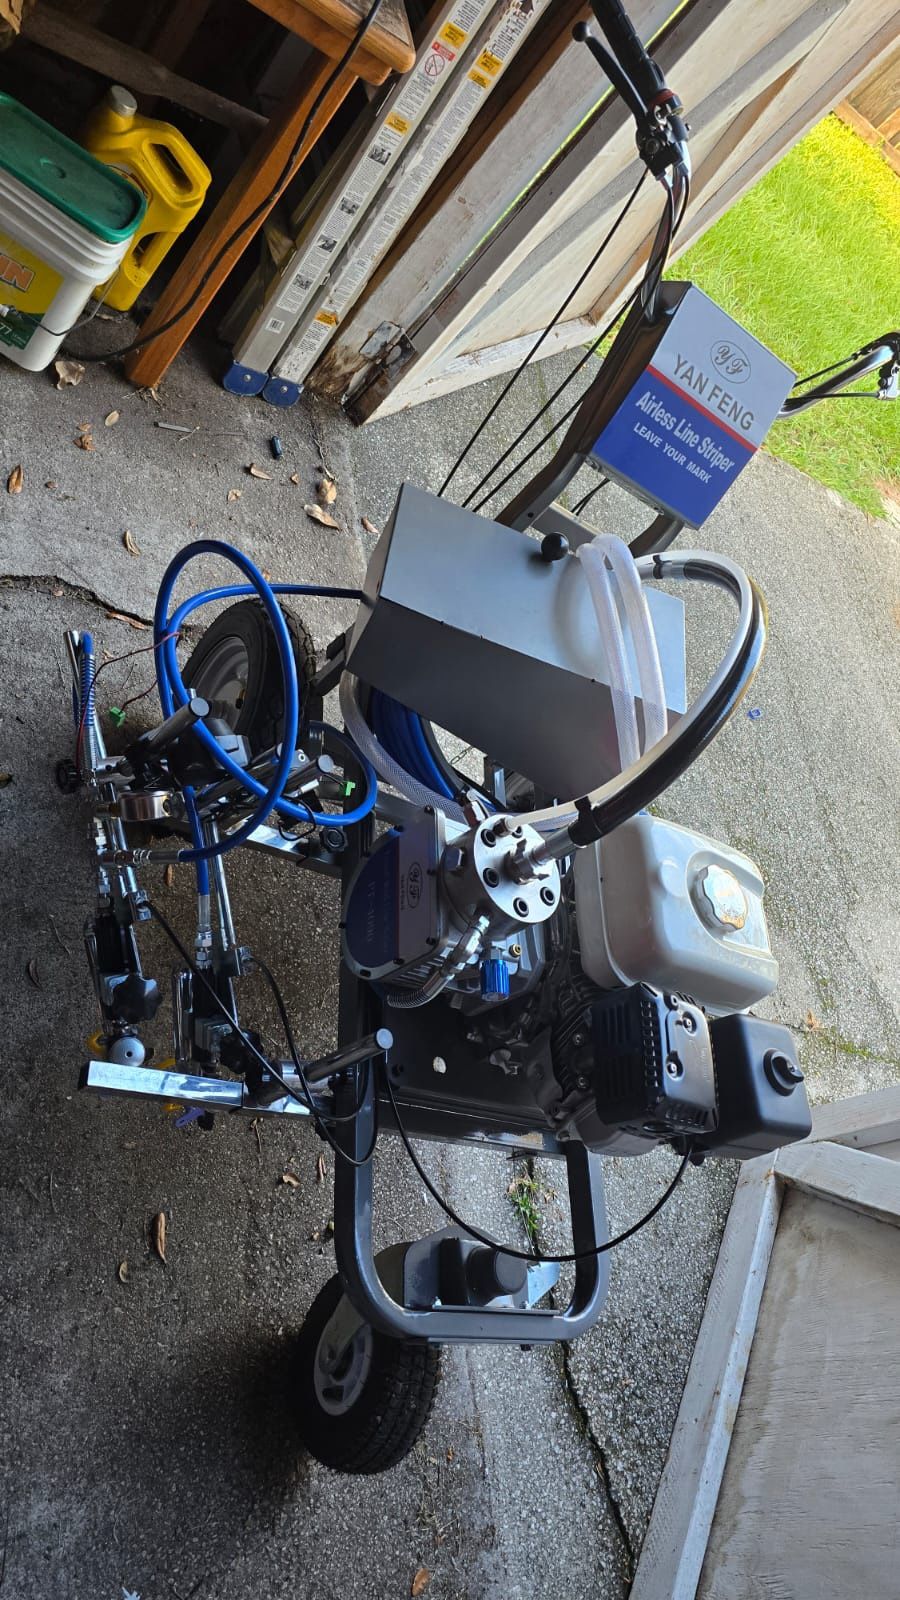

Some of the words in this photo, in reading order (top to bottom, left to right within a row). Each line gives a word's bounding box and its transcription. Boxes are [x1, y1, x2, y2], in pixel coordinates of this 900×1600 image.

[673, 354, 709, 395] YAN
[707, 385, 754, 431] FENG
[633, 422, 663, 447] LEAVE
[662, 443, 686, 466] YOUR
[686, 462, 712, 484] MARK
[636, 391, 676, 430] Airless
[673, 418, 699, 448] Line
[697, 436, 735, 473] Striper
